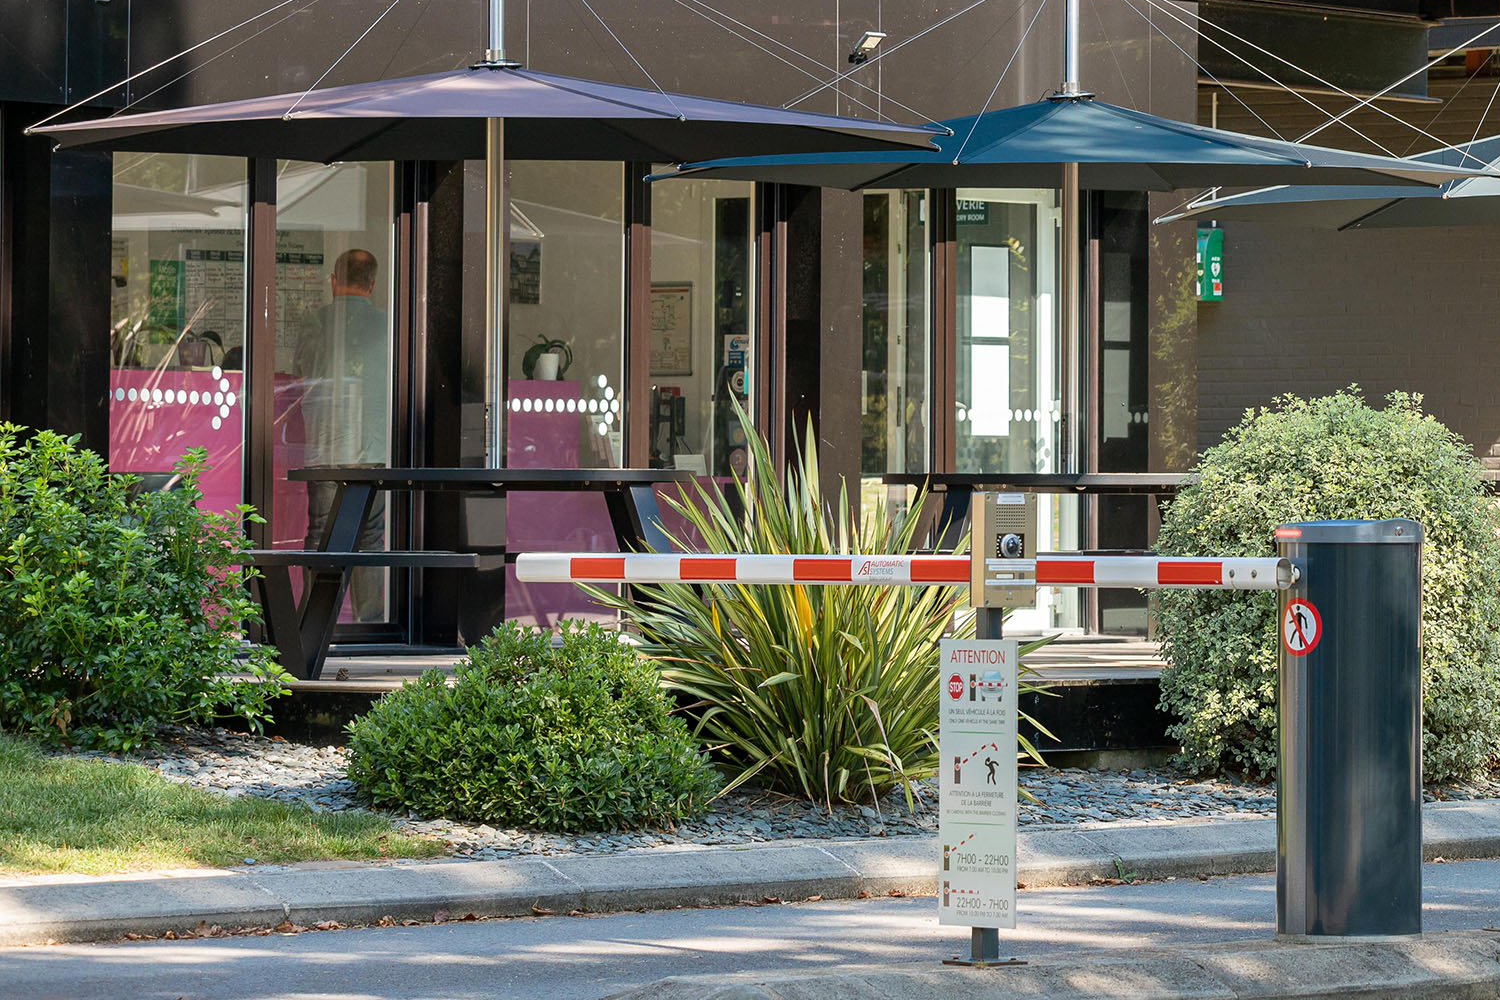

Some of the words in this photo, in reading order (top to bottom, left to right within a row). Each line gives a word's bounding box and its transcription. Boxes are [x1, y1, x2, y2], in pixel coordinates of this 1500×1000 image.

[956, 200, 985, 210] VERIE
[950, 649, 1006, 664] ATTENTION
[949, 682, 963, 693] STOP
[957, 853, 977, 864] 7H00
[984, 854, 1009, 866] 22H00
[956, 897, 981, 909] 22H00
[989, 899, 1009, 911] 7H00
